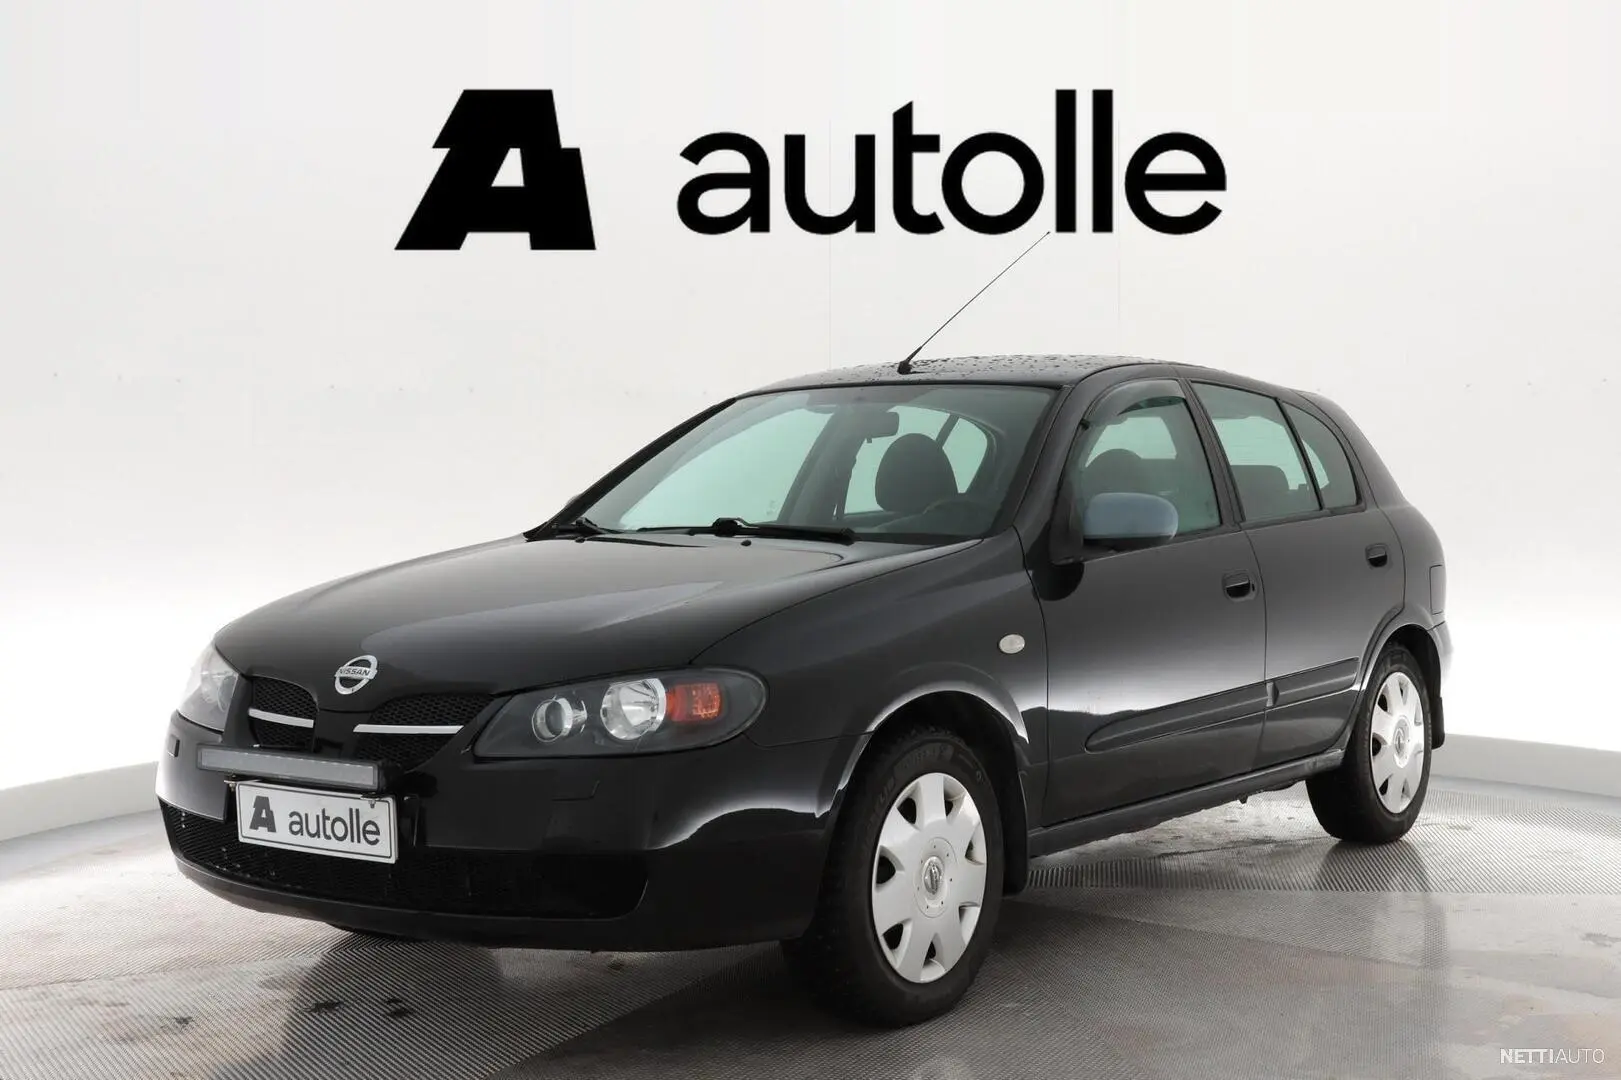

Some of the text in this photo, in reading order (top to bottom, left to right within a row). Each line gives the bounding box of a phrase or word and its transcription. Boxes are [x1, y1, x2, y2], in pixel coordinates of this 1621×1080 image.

[676, 89, 1227, 236] autolle
[338, 667, 371, 677] NISSAN
[287, 807, 381, 846] autolle
